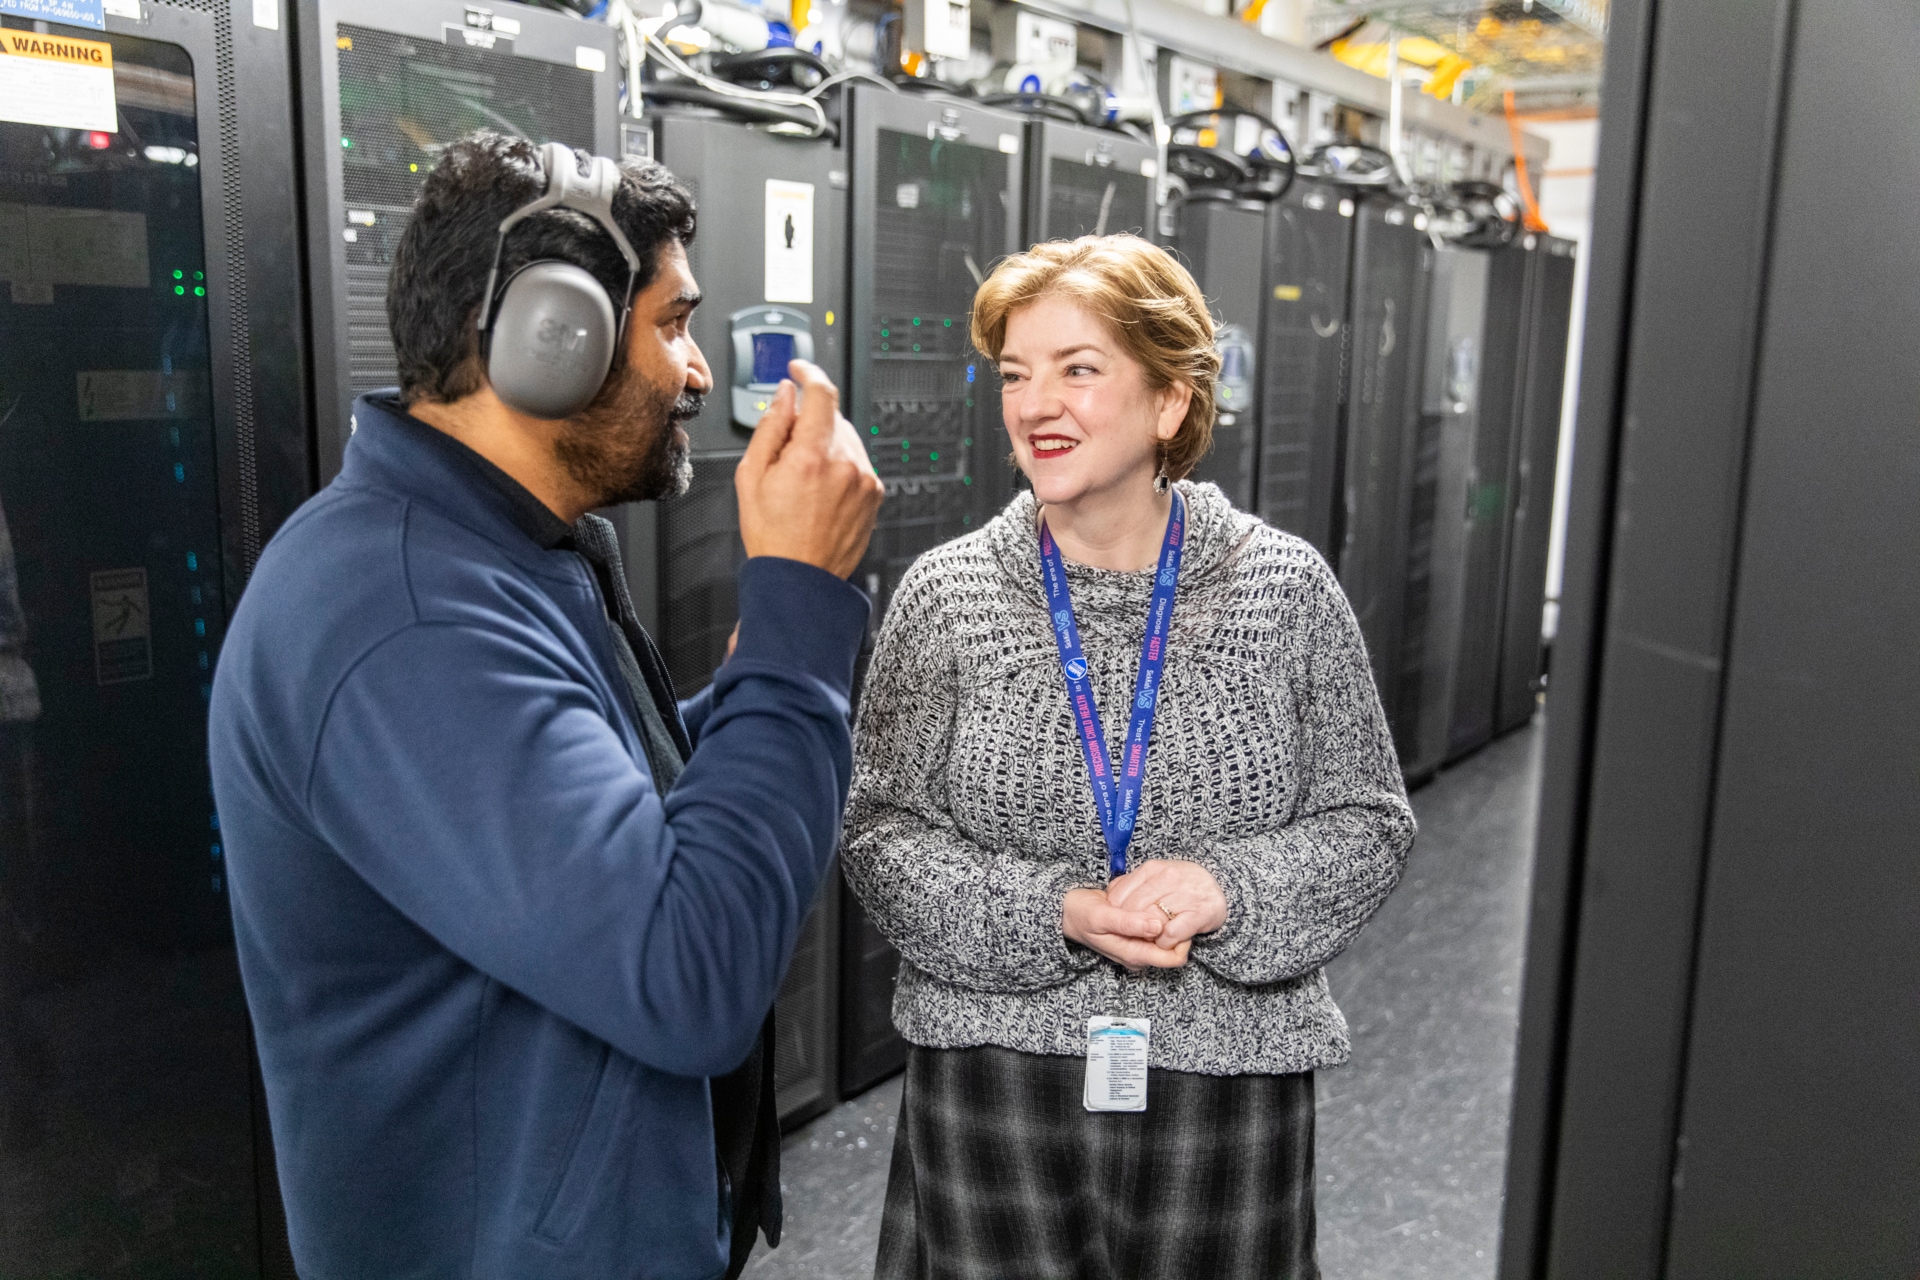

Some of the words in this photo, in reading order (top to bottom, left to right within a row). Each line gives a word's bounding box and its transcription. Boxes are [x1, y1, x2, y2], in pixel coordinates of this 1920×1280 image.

[12, 36, 103, 63] WARNING
[1169, 521, 1181, 546] BETTER
[1046, 558, 1054, 567] of
[1049, 567, 1058, 581] era
[1159, 566, 1176, 587] VS
[1052, 582, 1061, 598] The
[1054, 609, 1071, 632] VS
[1153, 597, 1167, 635] Diagnose
[1147, 636, 1161, 661] FASTER
[1075, 684, 1082, 692] is
[1143, 669, 1154, 690] SickKids
[1076, 694, 1090, 719] HEALTH
[1137, 688, 1154, 709] VS
[1082, 719, 1097, 739] CHILD
[1134, 718, 1146, 742] Treat
[1088, 740, 1106, 777] PRECISION
[1126, 743, 1142, 777] SMARTER
[1098, 780, 1107, 791] of
[1102, 792, 1111, 808] era
[1123, 788, 1134, 811] SickKids
[1105, 809, 1114, 826] The
[1118, 809, 1134, 831] VS
